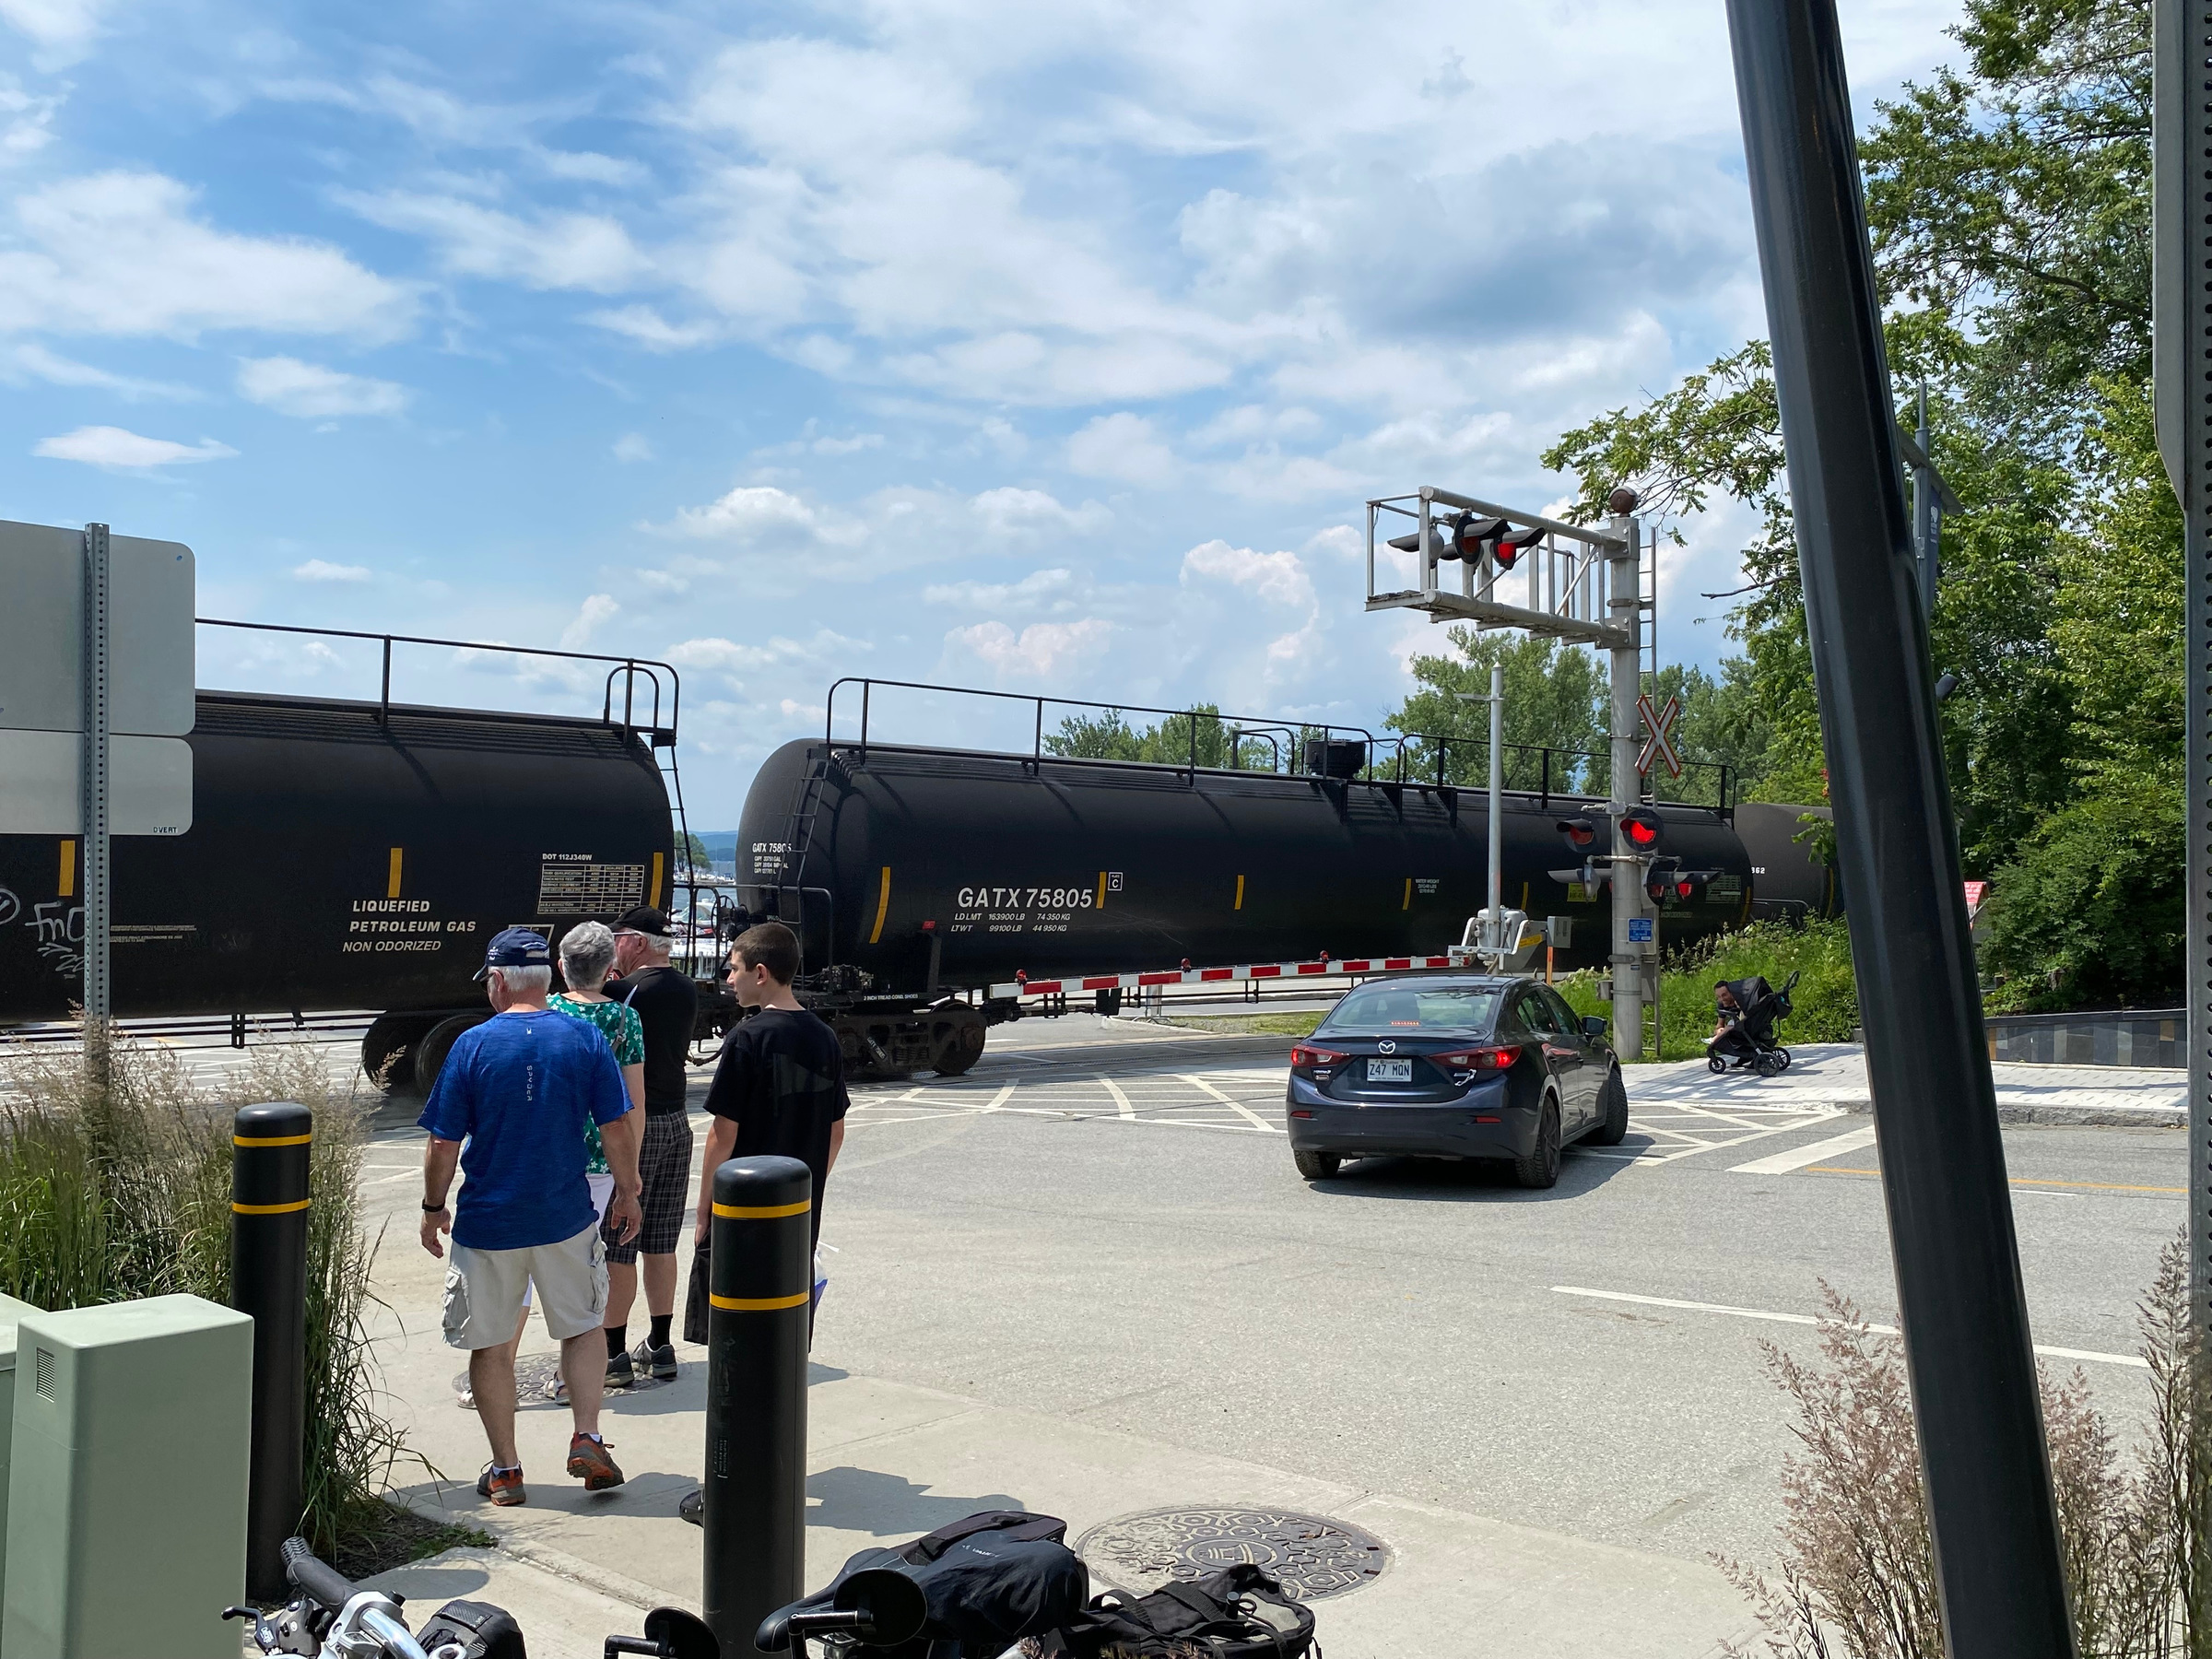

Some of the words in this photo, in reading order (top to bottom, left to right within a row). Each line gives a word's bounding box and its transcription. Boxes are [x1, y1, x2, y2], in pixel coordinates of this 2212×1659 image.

[752, 842, 767, 853] GATX
[1112, 878, 1119, 888] C
[957, 887, 1021, 908] GATX
[1025, 888, 1093, 910] 75805
[352, 900, 430, 912] LIQUEFIED
[988, 912, 1016, 921] 163900
[1016, 912, 1026, 921] LB
[1036, 912, 1046, 921] 74
[1046, 912, 1061, 921] 350
[1061, 912, 1071, 921] KG
[349, 921, 441, 933] PETROLEUM
[446, 921, 477, 932] GAS
[989, 924, 1012, 933] 99100
[1012, 924, 1022, 933] LB
[1032, 924, 1042, 933] 44
[1042, 924, 1057, 933] 950
[1057, 924, 1067, 933] KG
[342, 941, 372, 953] NON
[374, 940, 441, 952] ODORIZED
[1369, 1064, 1387, 1076] Z47
[1392, 1064, 1410, 1077] MQN
